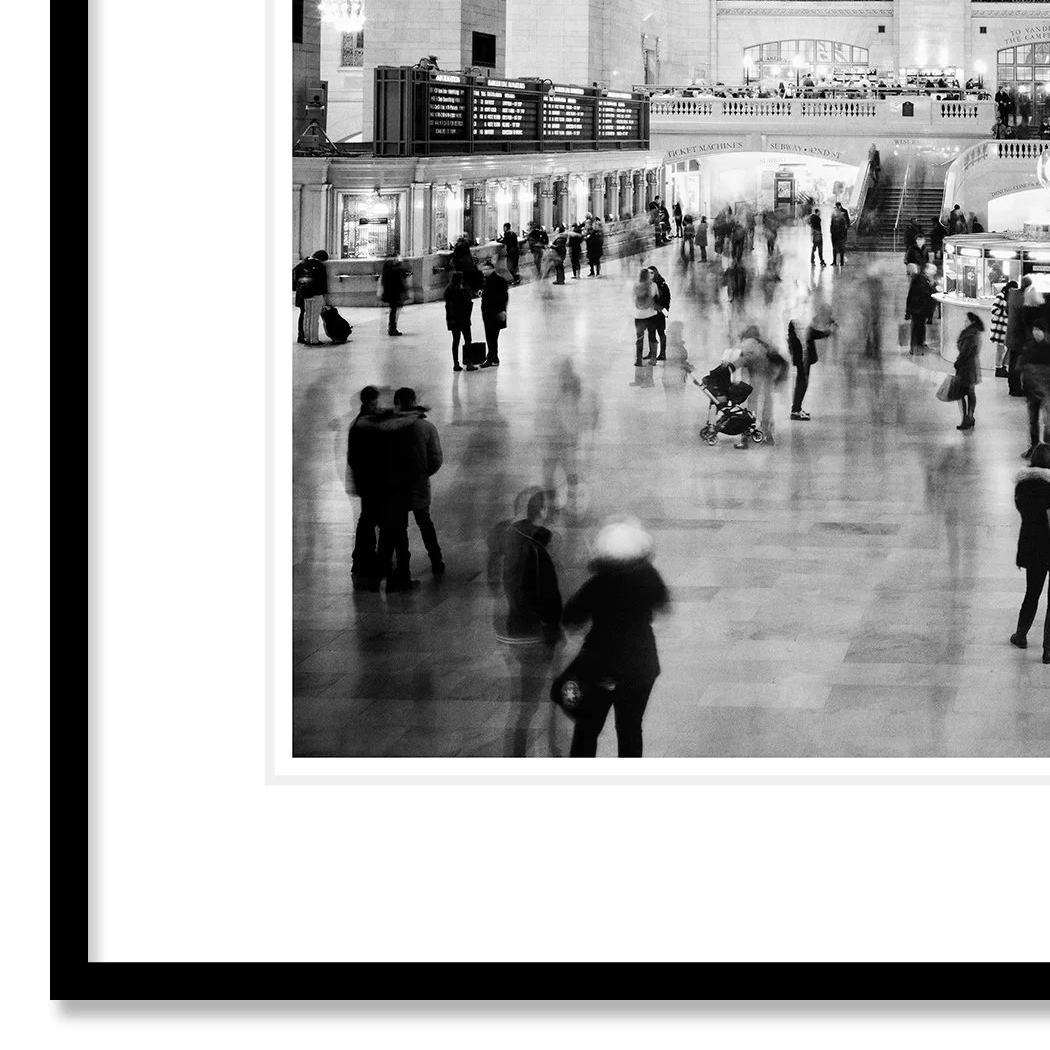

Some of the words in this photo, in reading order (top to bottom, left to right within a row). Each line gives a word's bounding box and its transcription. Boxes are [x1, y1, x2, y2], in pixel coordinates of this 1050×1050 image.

[667, 146, 697, 158] TICKET
[699, 141, 743, 152] MACHINES
[770, 142, 802, 152] SUBWAY
